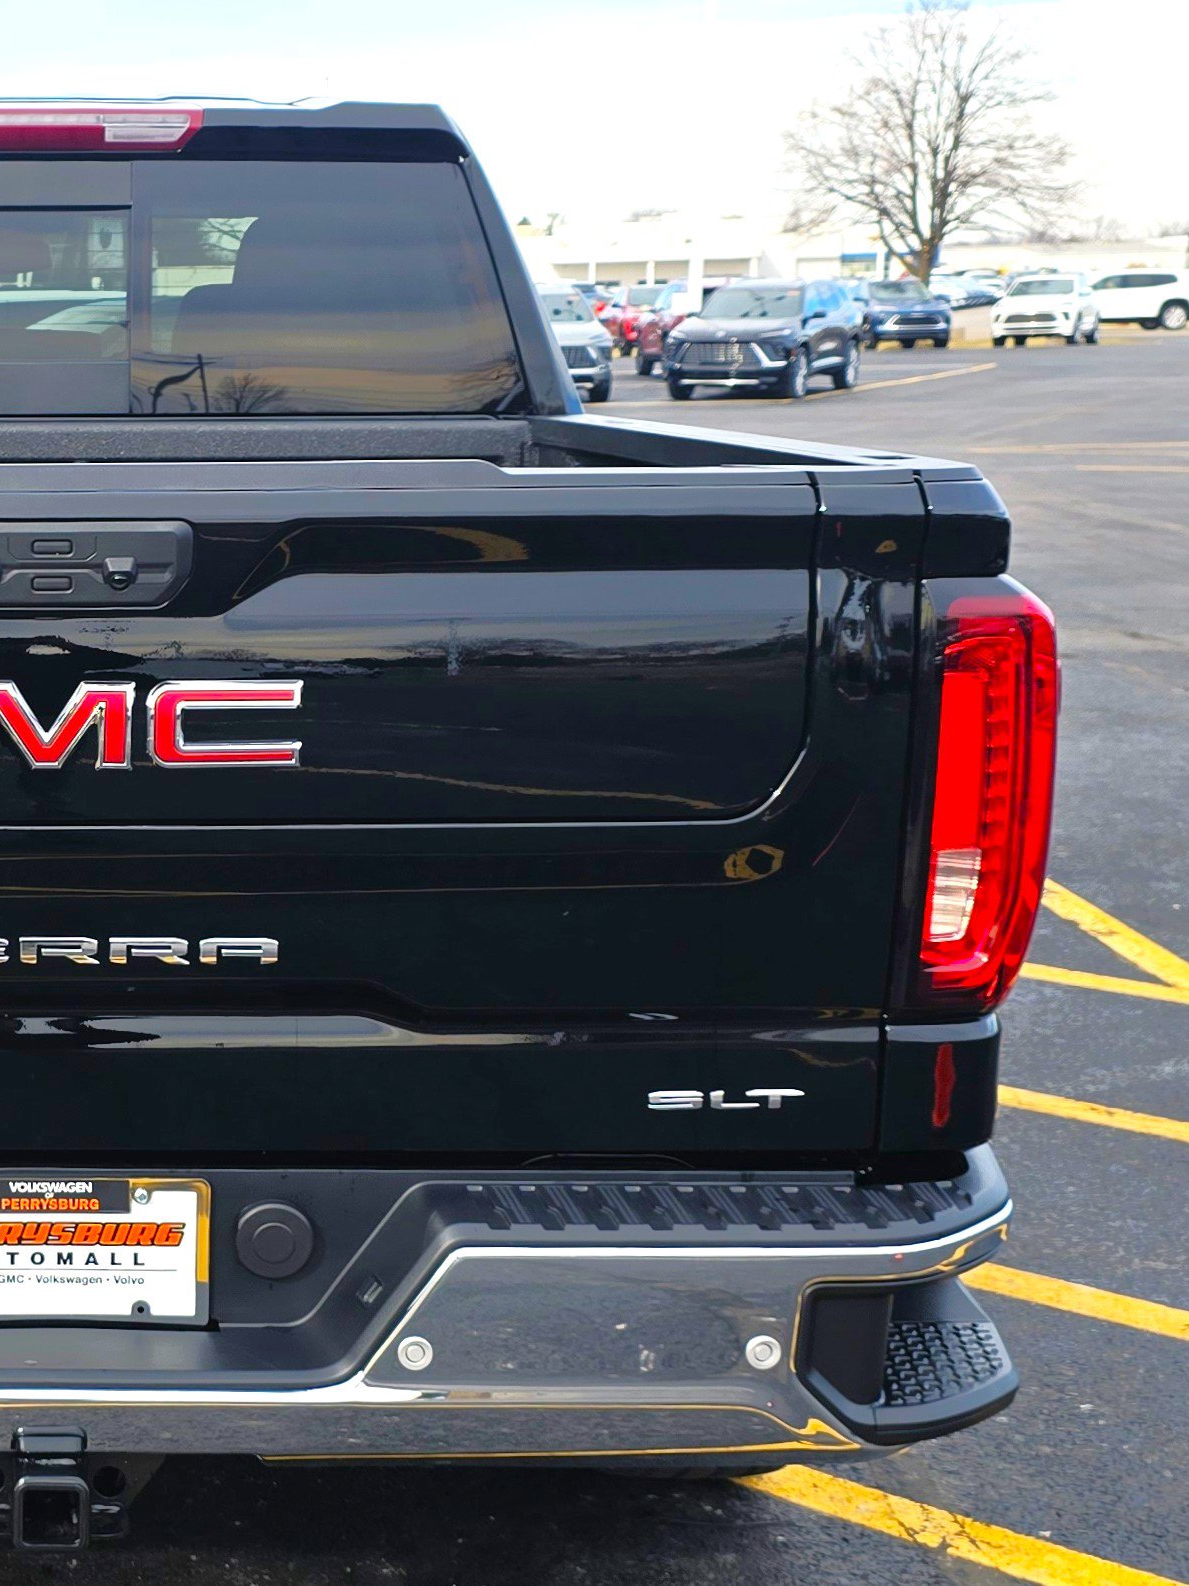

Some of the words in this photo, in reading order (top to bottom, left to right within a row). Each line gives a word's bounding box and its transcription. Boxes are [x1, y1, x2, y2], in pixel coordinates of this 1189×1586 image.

[647, 1088, 806, 1110] SLT
[9, 1181, 93, 1193] VOLKSWAGEN
[0, 1198, 100, 1211] PERRYSBURG
[35, 1274, 103, 1286] Volkswagen
[113, 1275, 145, 1285] Volvo
